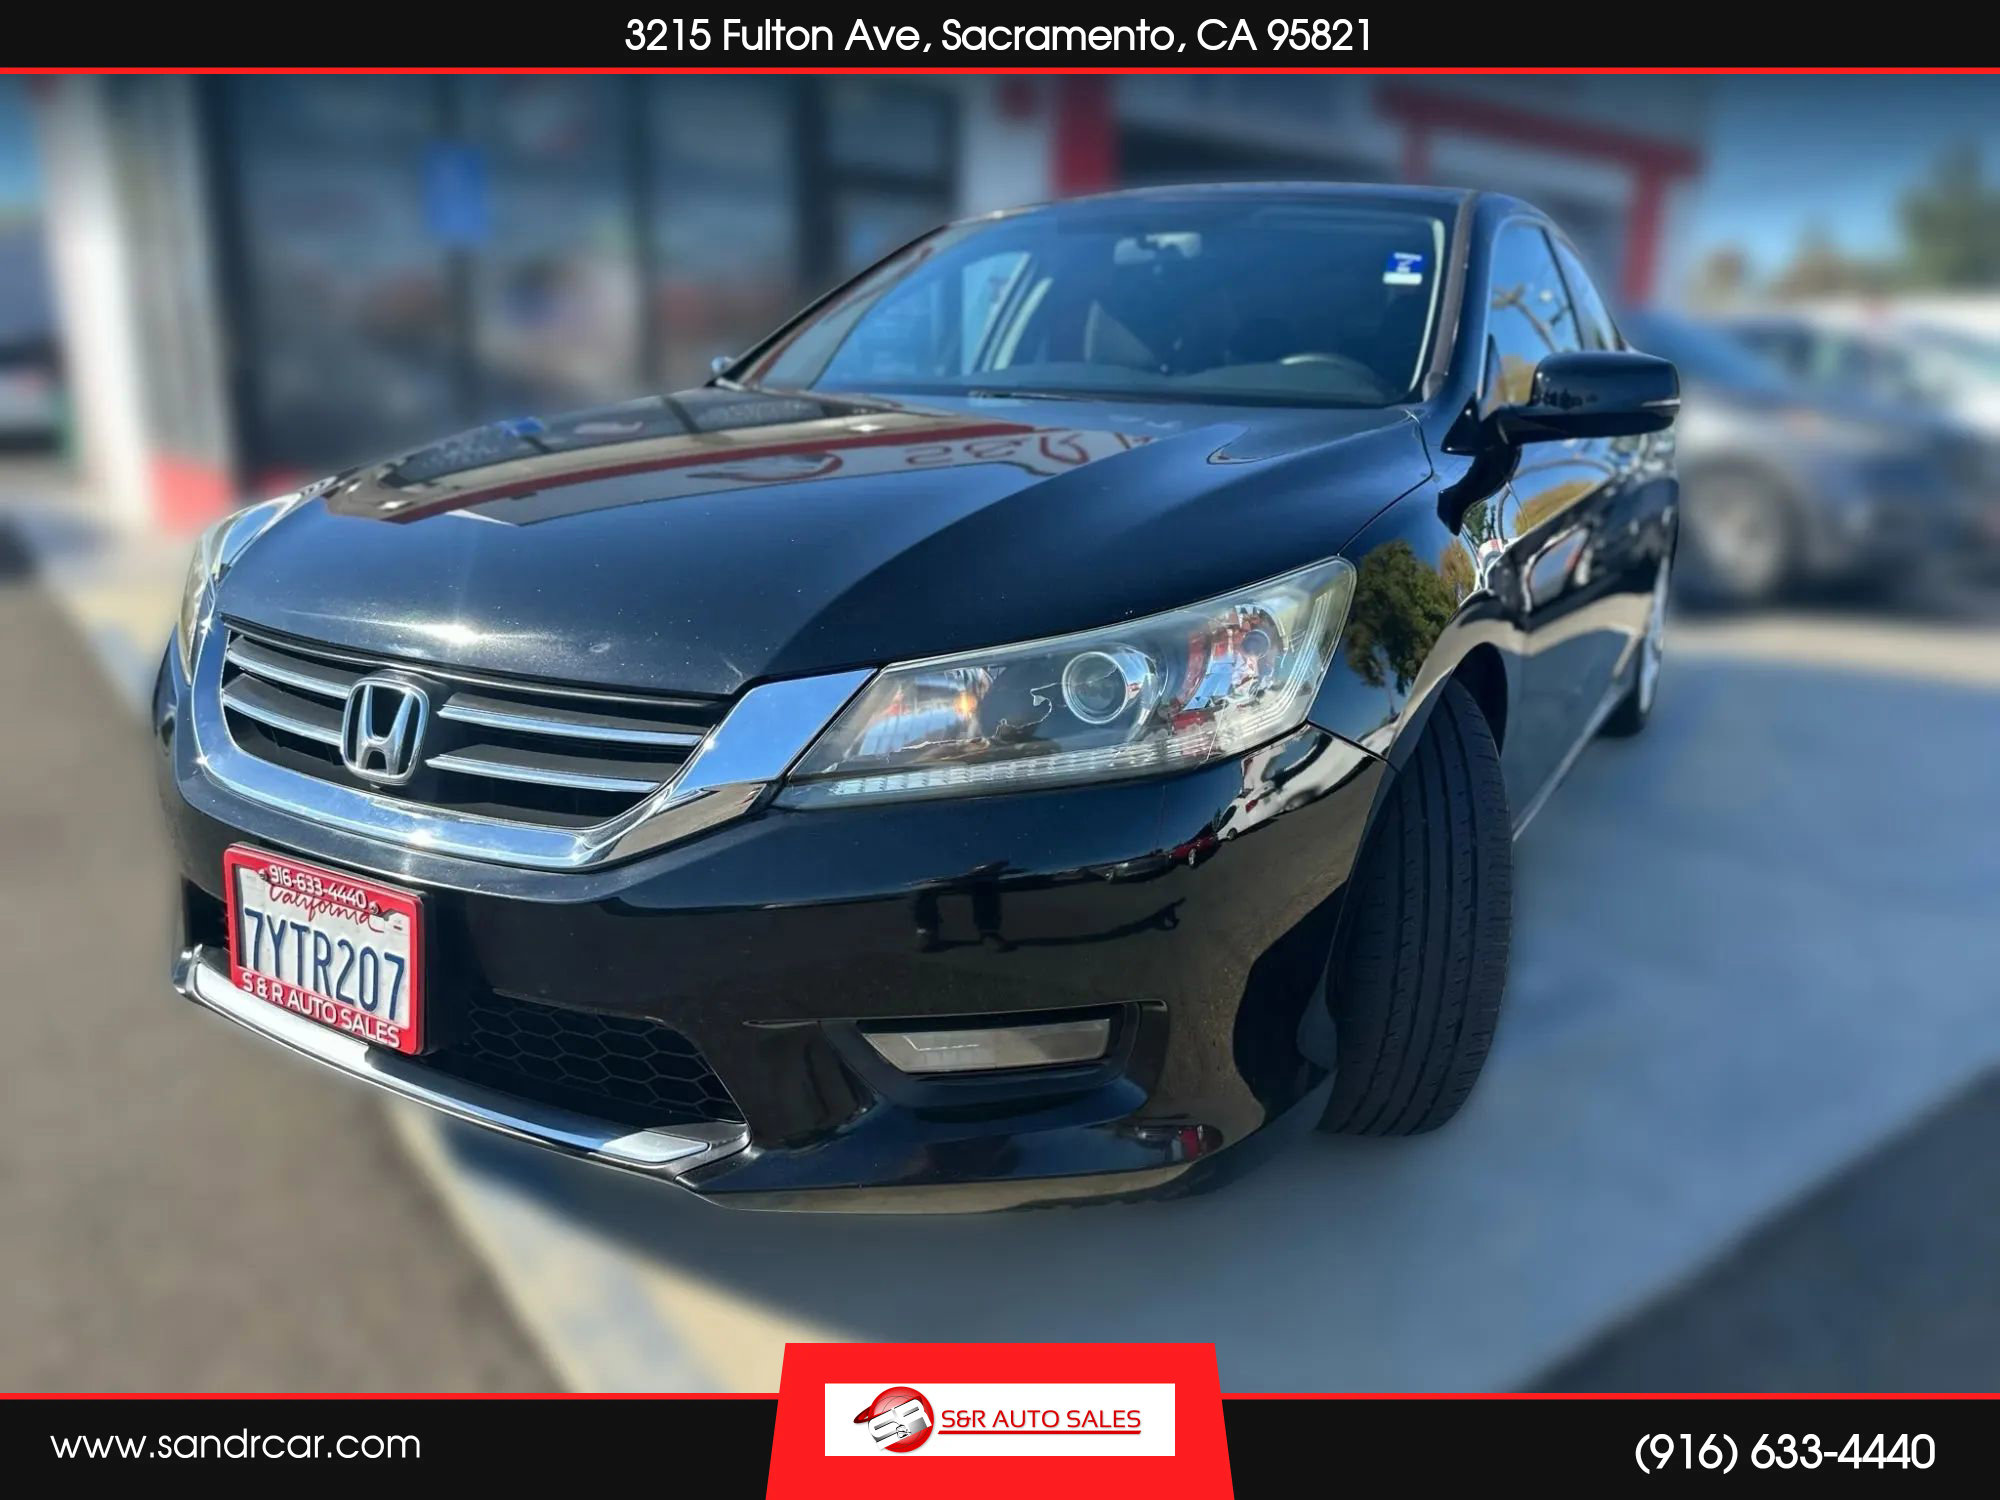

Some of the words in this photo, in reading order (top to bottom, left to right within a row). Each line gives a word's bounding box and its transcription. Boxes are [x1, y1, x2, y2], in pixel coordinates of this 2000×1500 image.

[269, 864, 368, 910] 916-633-4440
[244, 906, 405, 1021] 7YTR207
[242, 972, 253, 993] S
[256, 978, 268, 999] &
[271, 983, 284, 1005] R
[287, 991, 337, 1025] AUTO
[340, 1009, 400, 1049] SALES
